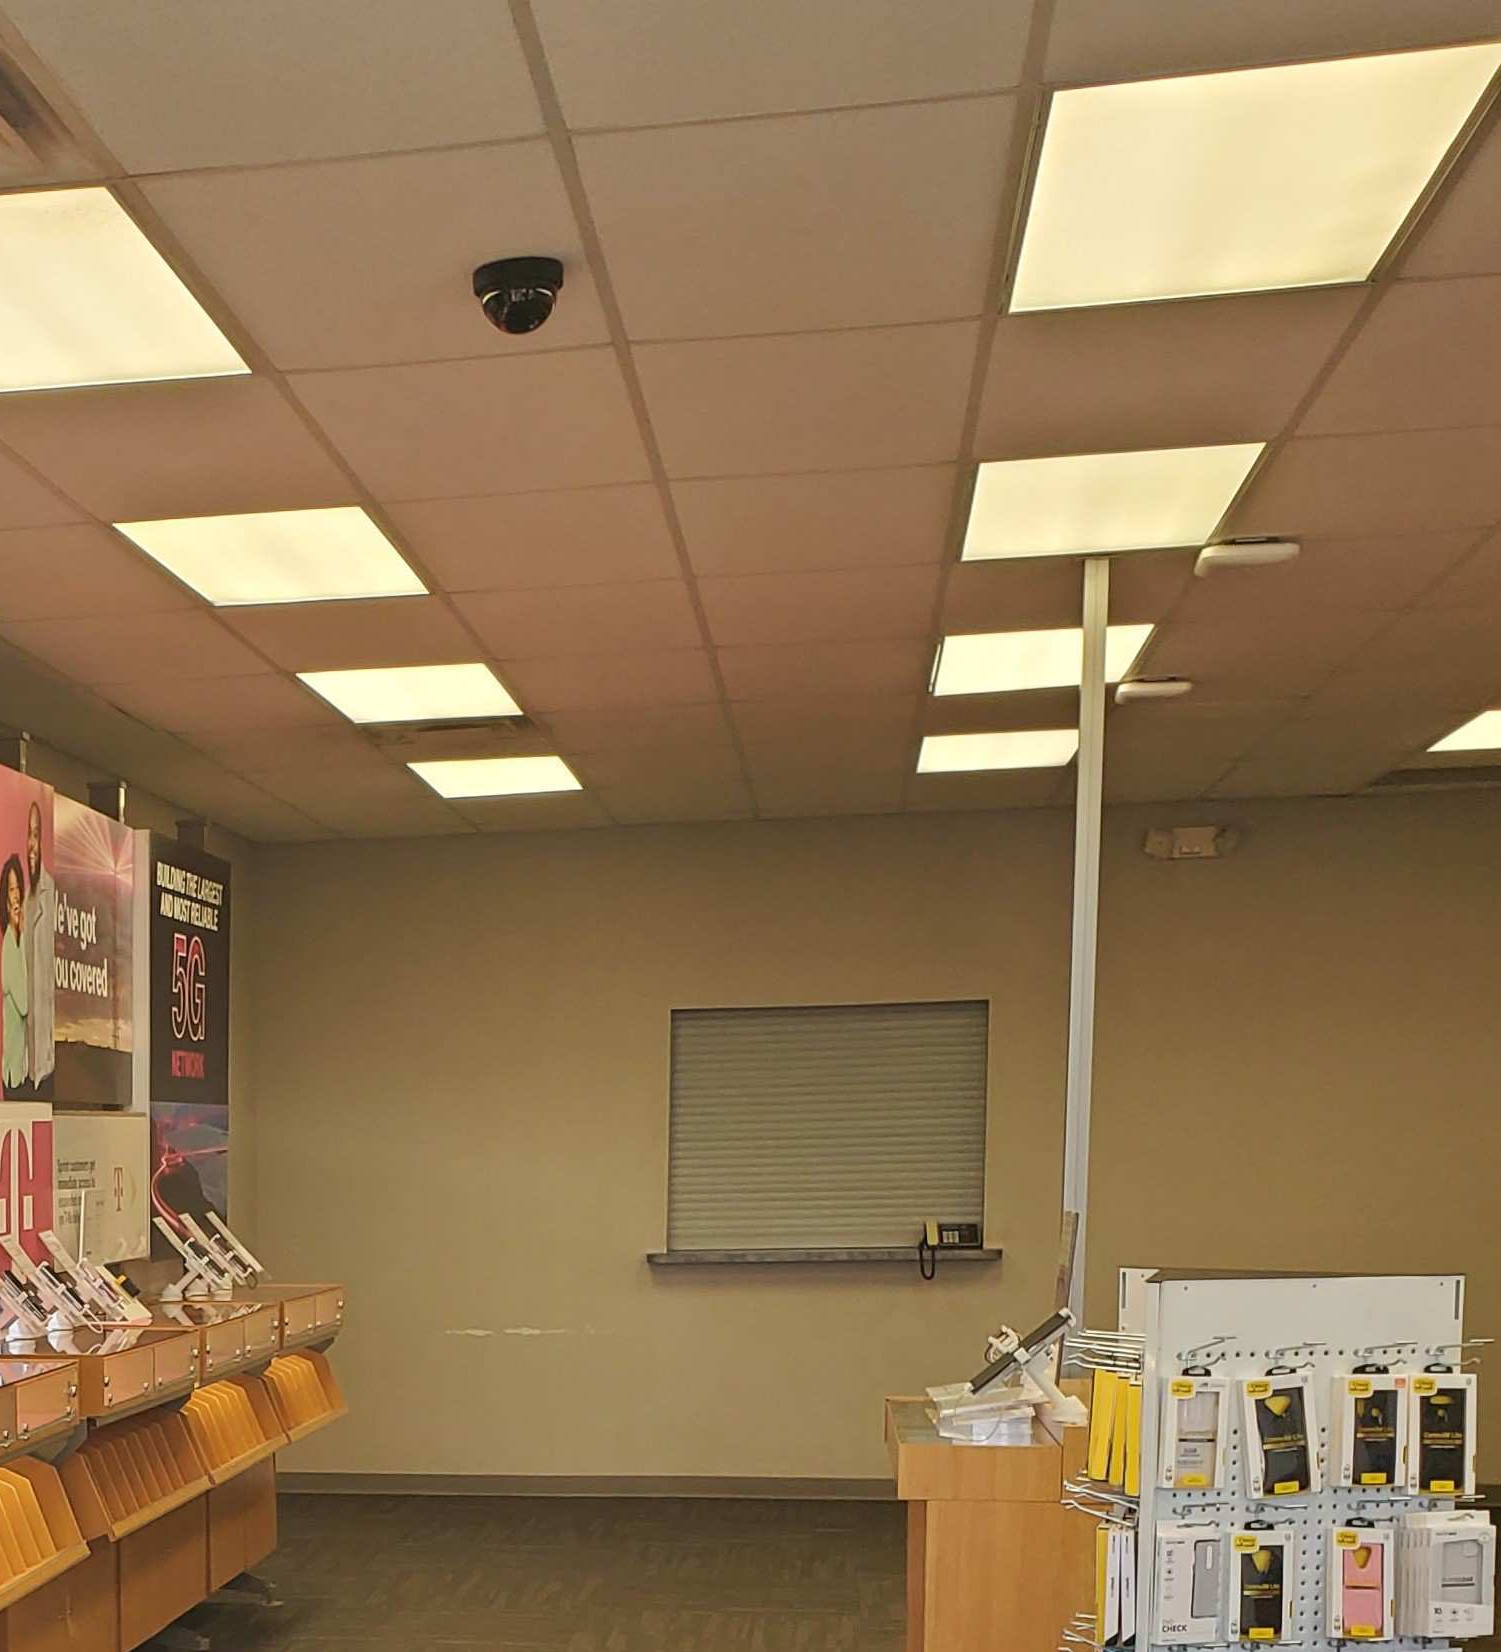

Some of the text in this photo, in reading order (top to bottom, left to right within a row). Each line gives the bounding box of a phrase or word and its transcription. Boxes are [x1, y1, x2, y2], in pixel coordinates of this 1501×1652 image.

[80, 906, 97, 951] got
[54, 957, 108, 998] ou covered
[172, 932, 206, 1042] 5G
[1162, 1624, 1188, 1633] CHECK
